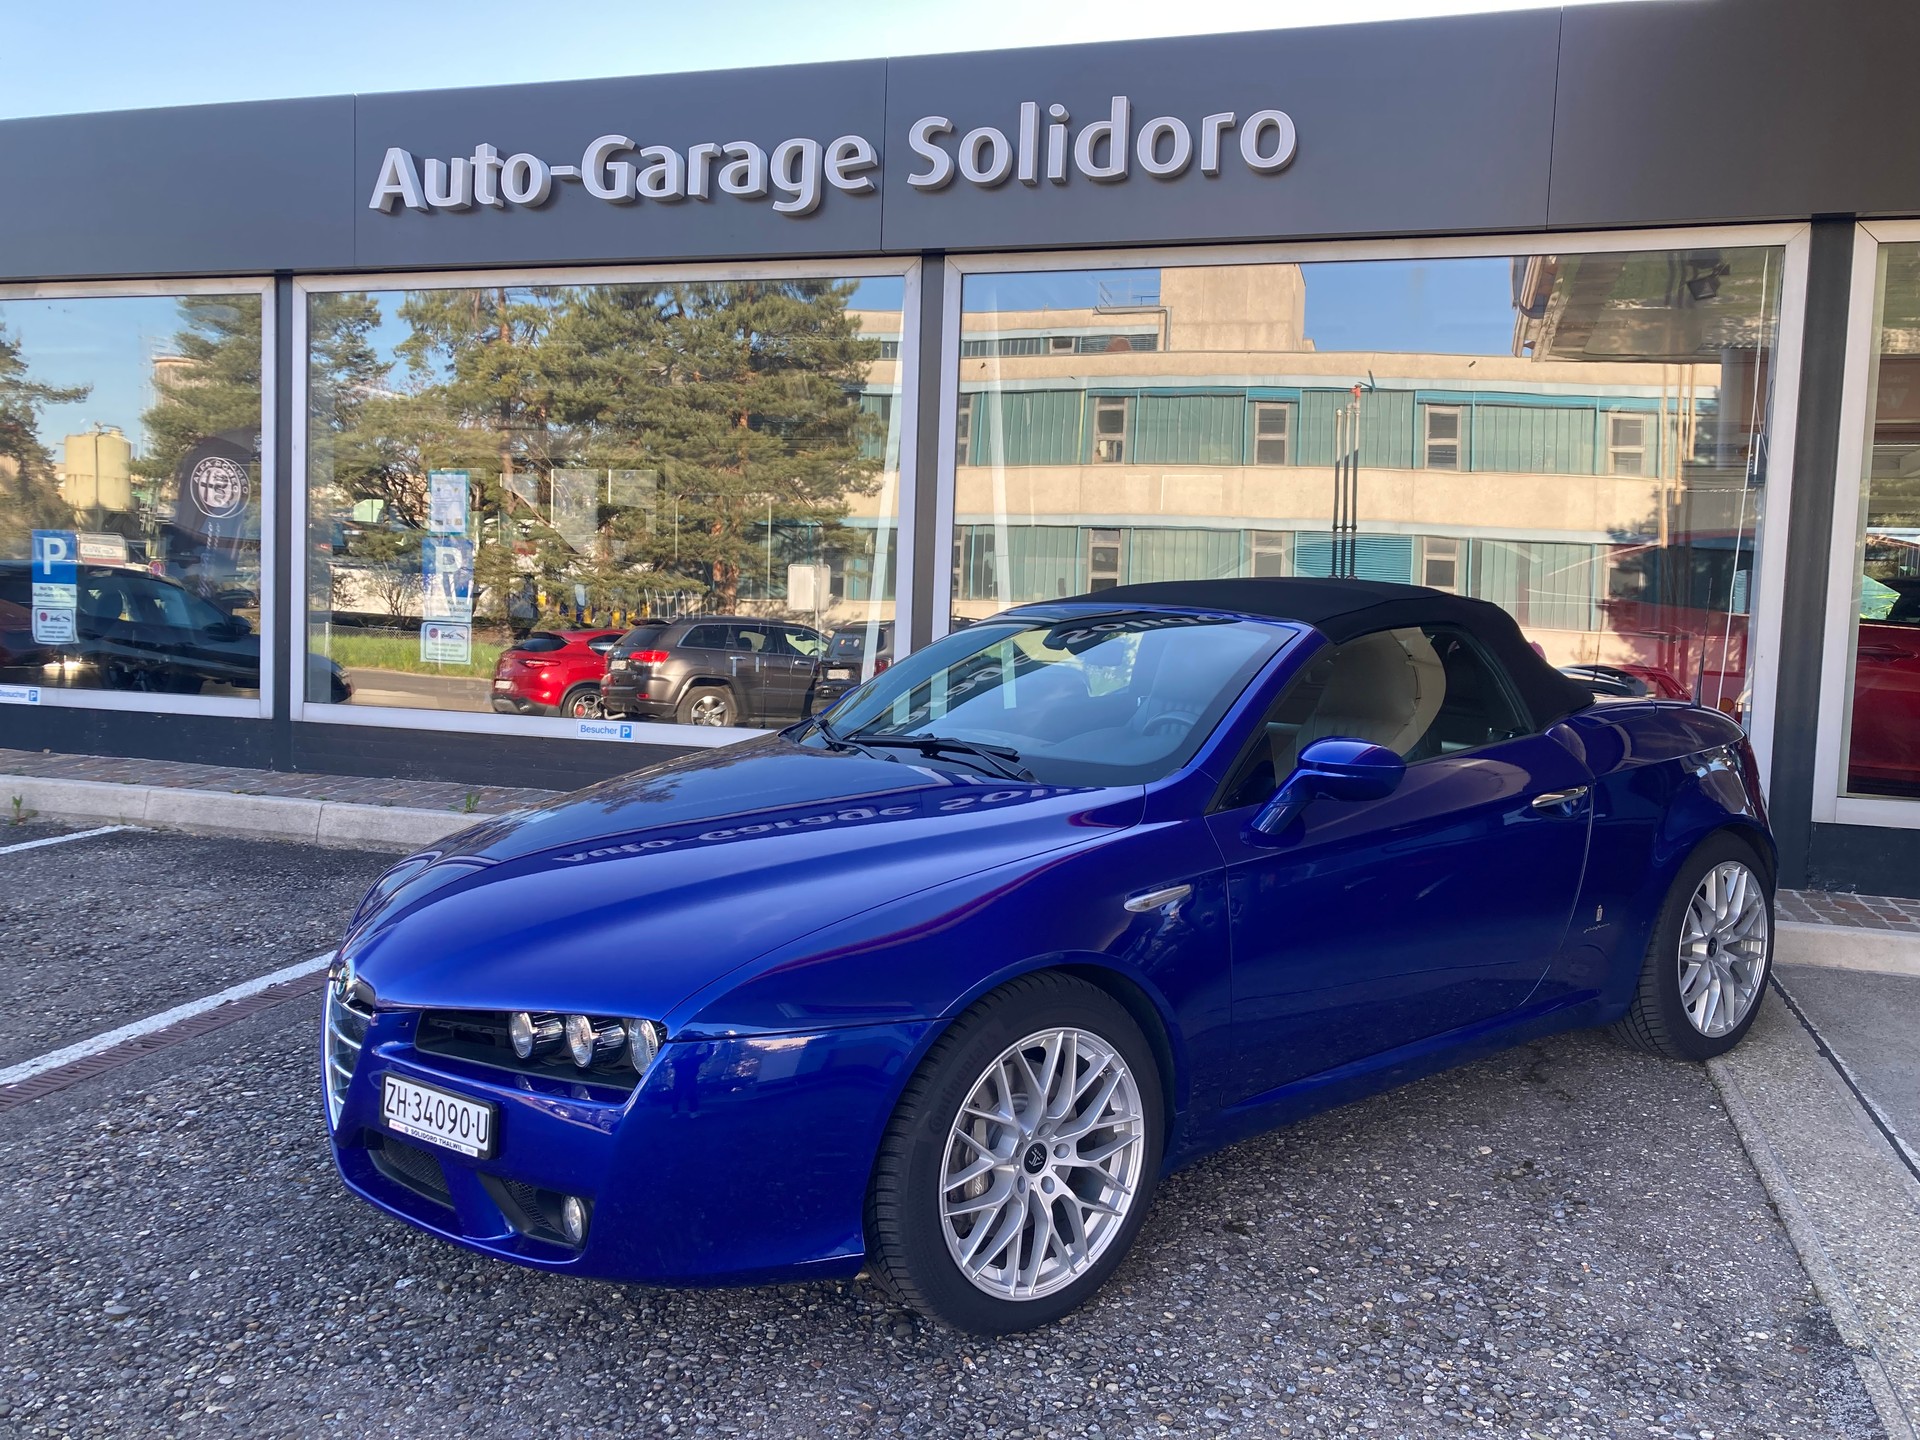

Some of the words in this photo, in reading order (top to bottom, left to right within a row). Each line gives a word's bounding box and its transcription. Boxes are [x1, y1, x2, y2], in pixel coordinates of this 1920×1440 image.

[368, 134, 878, 217] Auto-Garage
[907, 96, 1297, 190] Solidoro
[43, 537, 67, 575] P
[580, 724, 618, 735] Besucher
[410, 1128, 438, 1143] SOLIDORO
[439, 1138, 463, 1152] THALWIL
